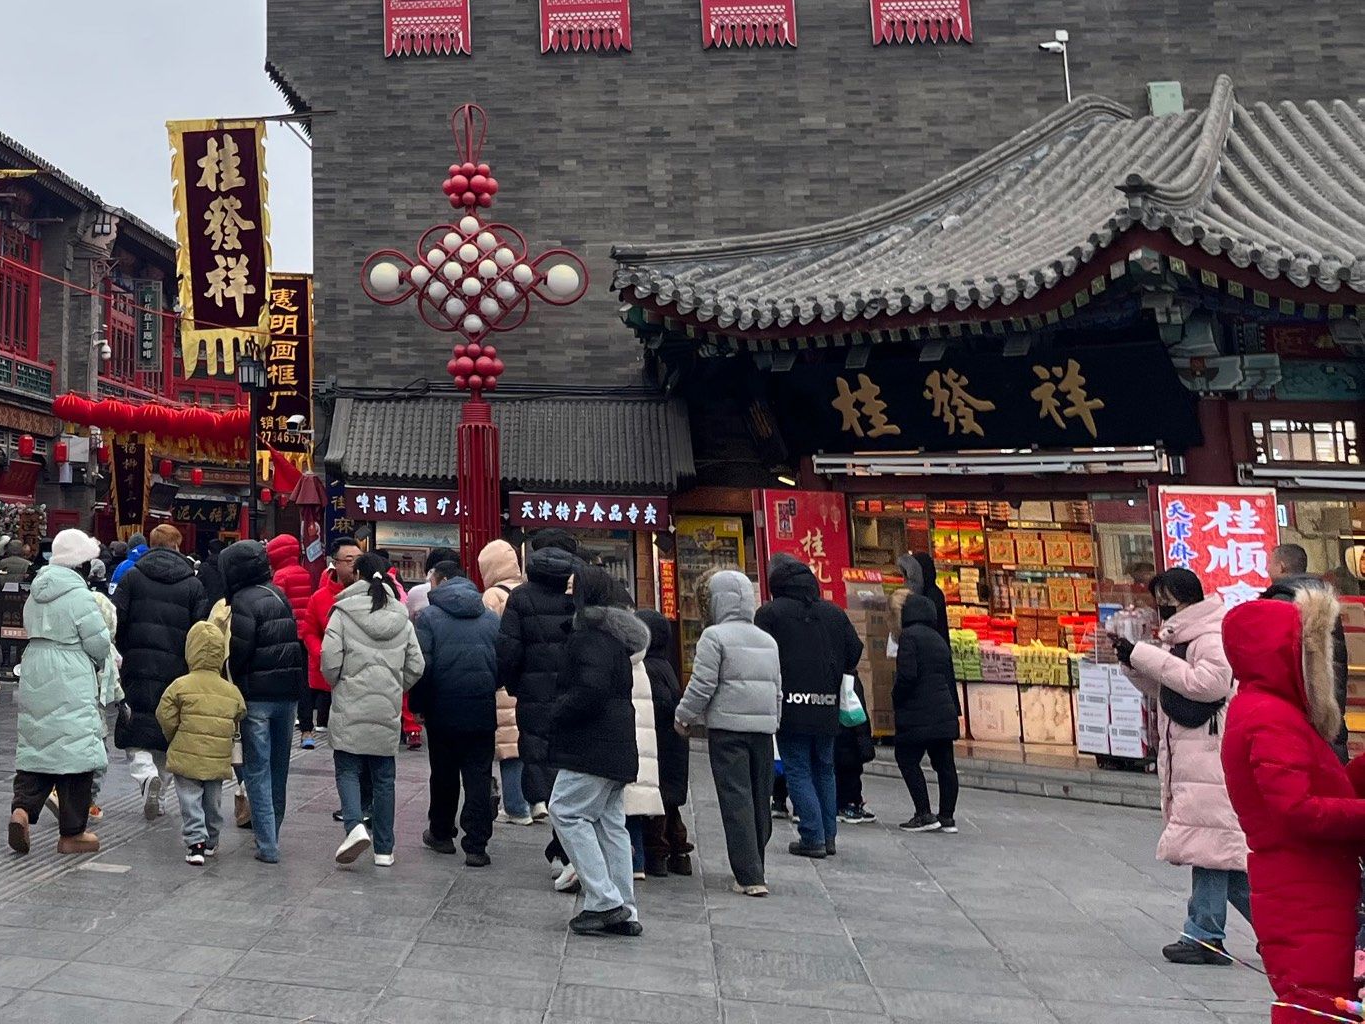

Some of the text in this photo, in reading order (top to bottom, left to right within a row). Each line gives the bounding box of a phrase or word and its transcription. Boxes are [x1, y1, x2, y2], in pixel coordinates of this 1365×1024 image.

[355, 491, 388, 514] 啤酒
[396, 494, 428, 515] 米酒
[520, 499, 658, 525] 天津特产食品专卖
